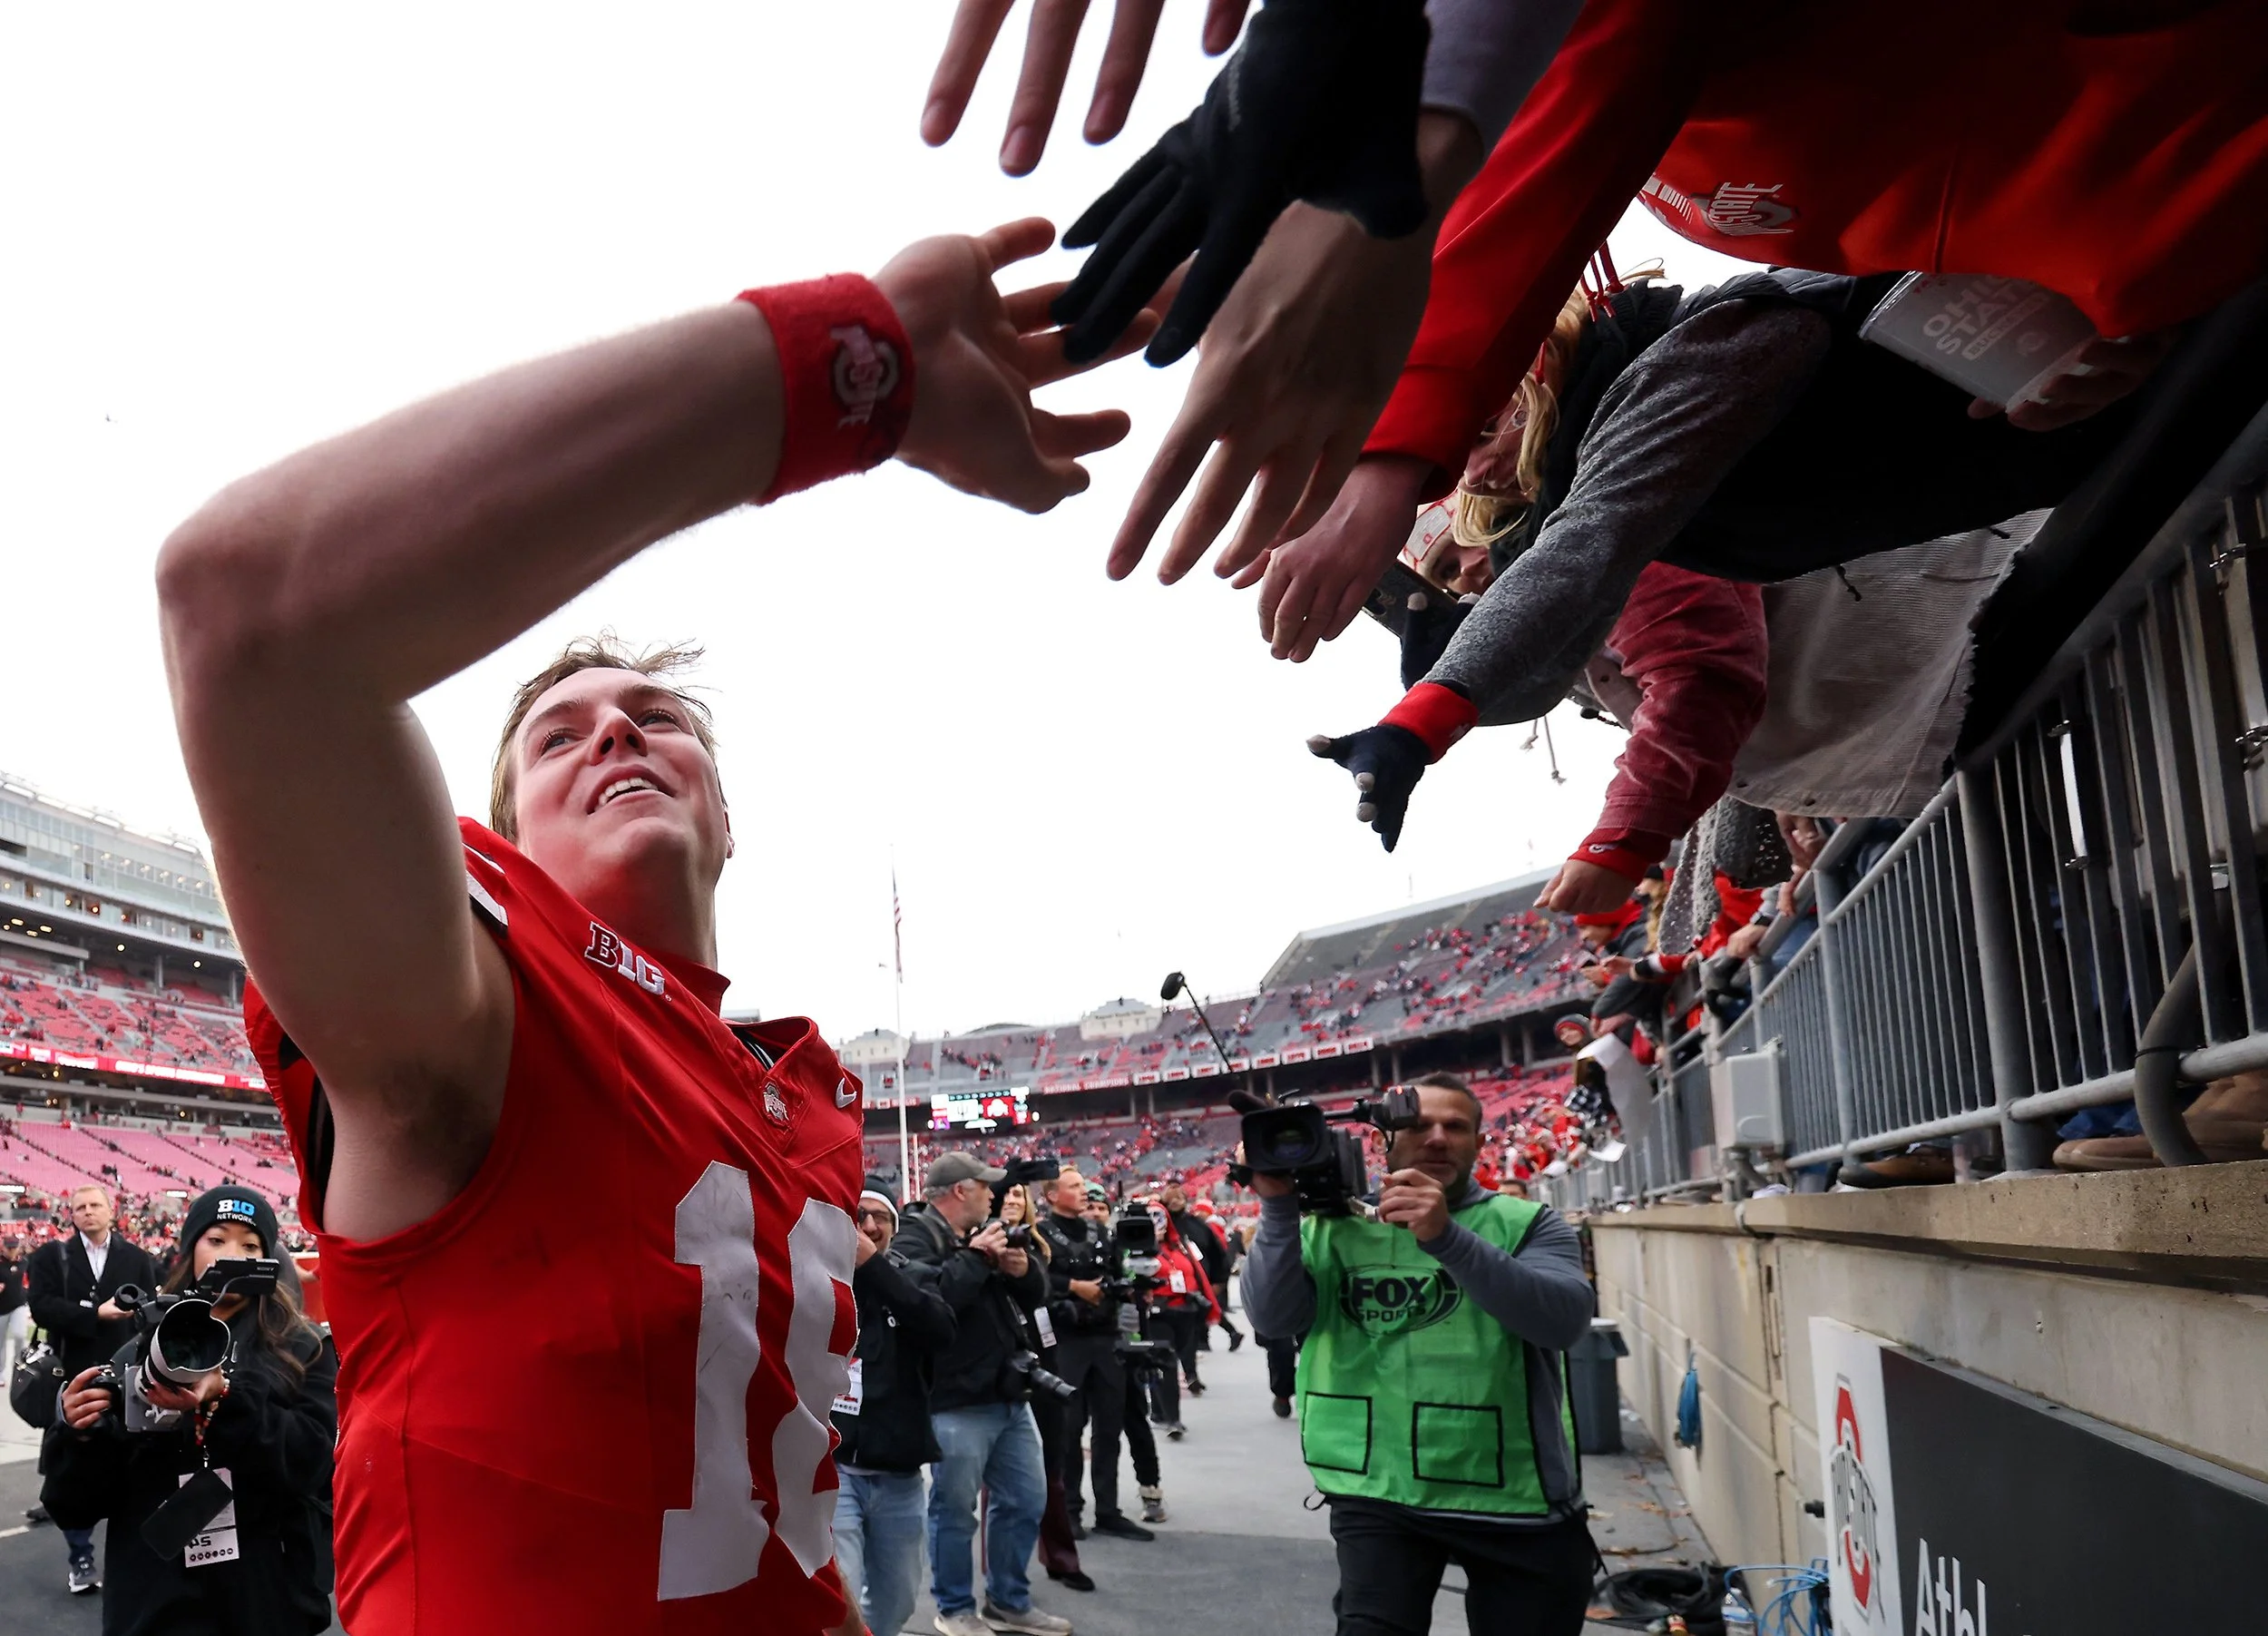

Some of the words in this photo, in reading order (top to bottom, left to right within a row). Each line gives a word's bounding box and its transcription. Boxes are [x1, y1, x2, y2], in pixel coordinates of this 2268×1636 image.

[1936, 281, 2021, 355] STAT
[217, 1212, 254, 1226] NETWORK
[1352, 1277, 1431, 1309] FOX
